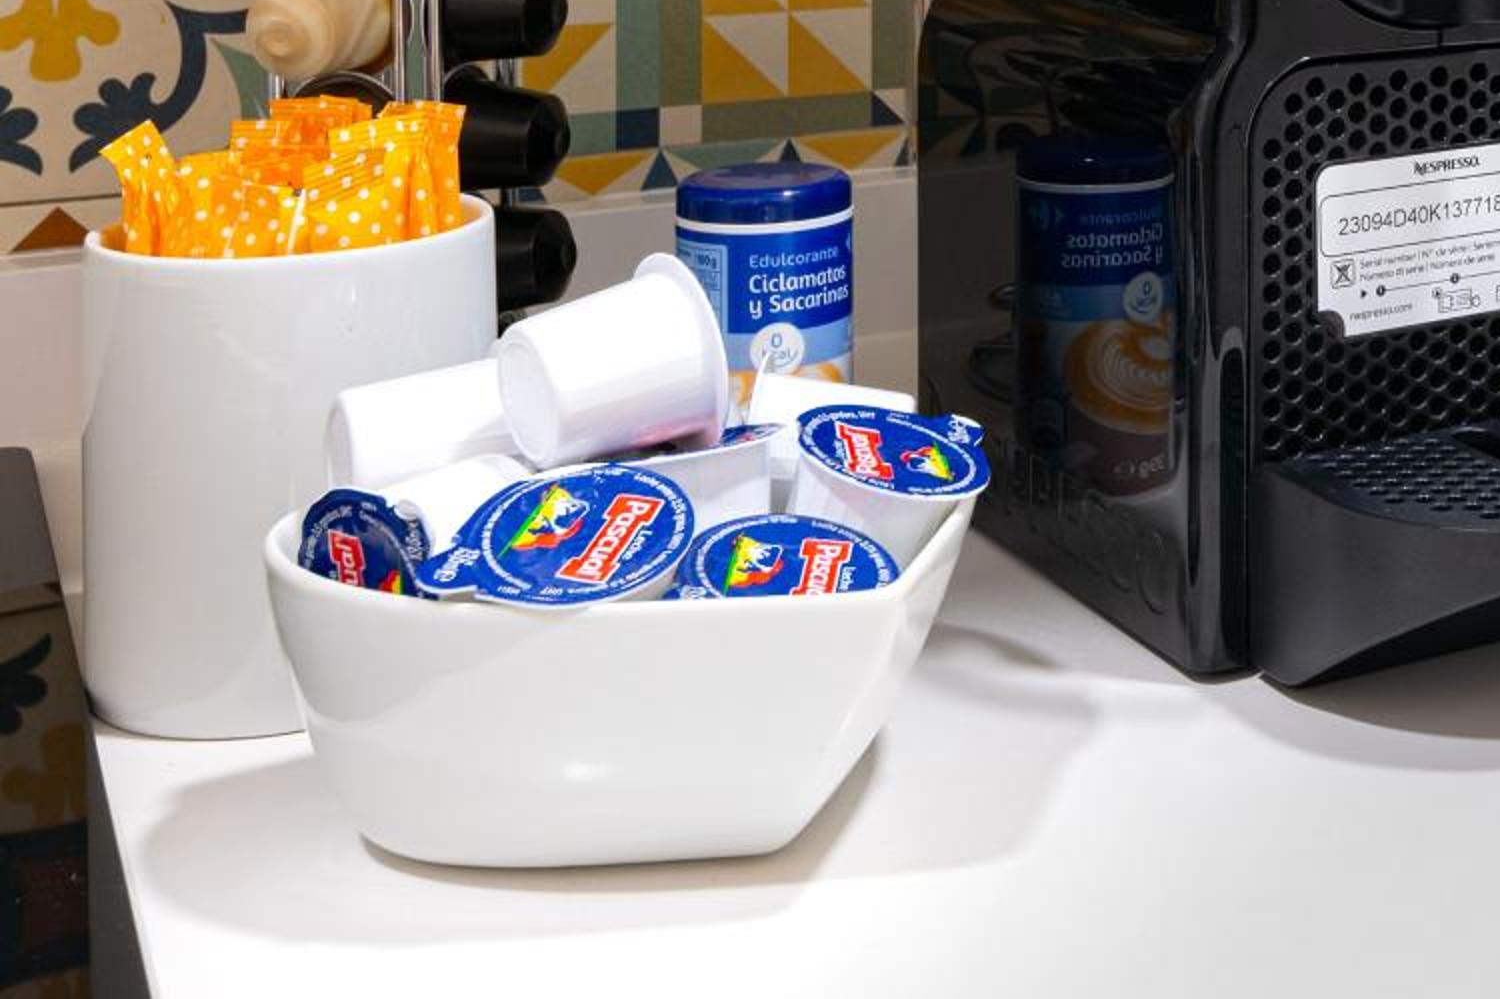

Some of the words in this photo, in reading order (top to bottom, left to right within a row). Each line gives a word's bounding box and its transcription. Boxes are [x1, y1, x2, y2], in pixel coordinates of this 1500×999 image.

[750, 246, 840, 269] Edulcorante
[749, 264, 847, 294] Ciclamatos
[749, 300, 763, 320] y
[769, 284, 849, 313] Sacarinas
[771, 333, 783, 349] 0
[575, 500, 648, 581] Pascual
